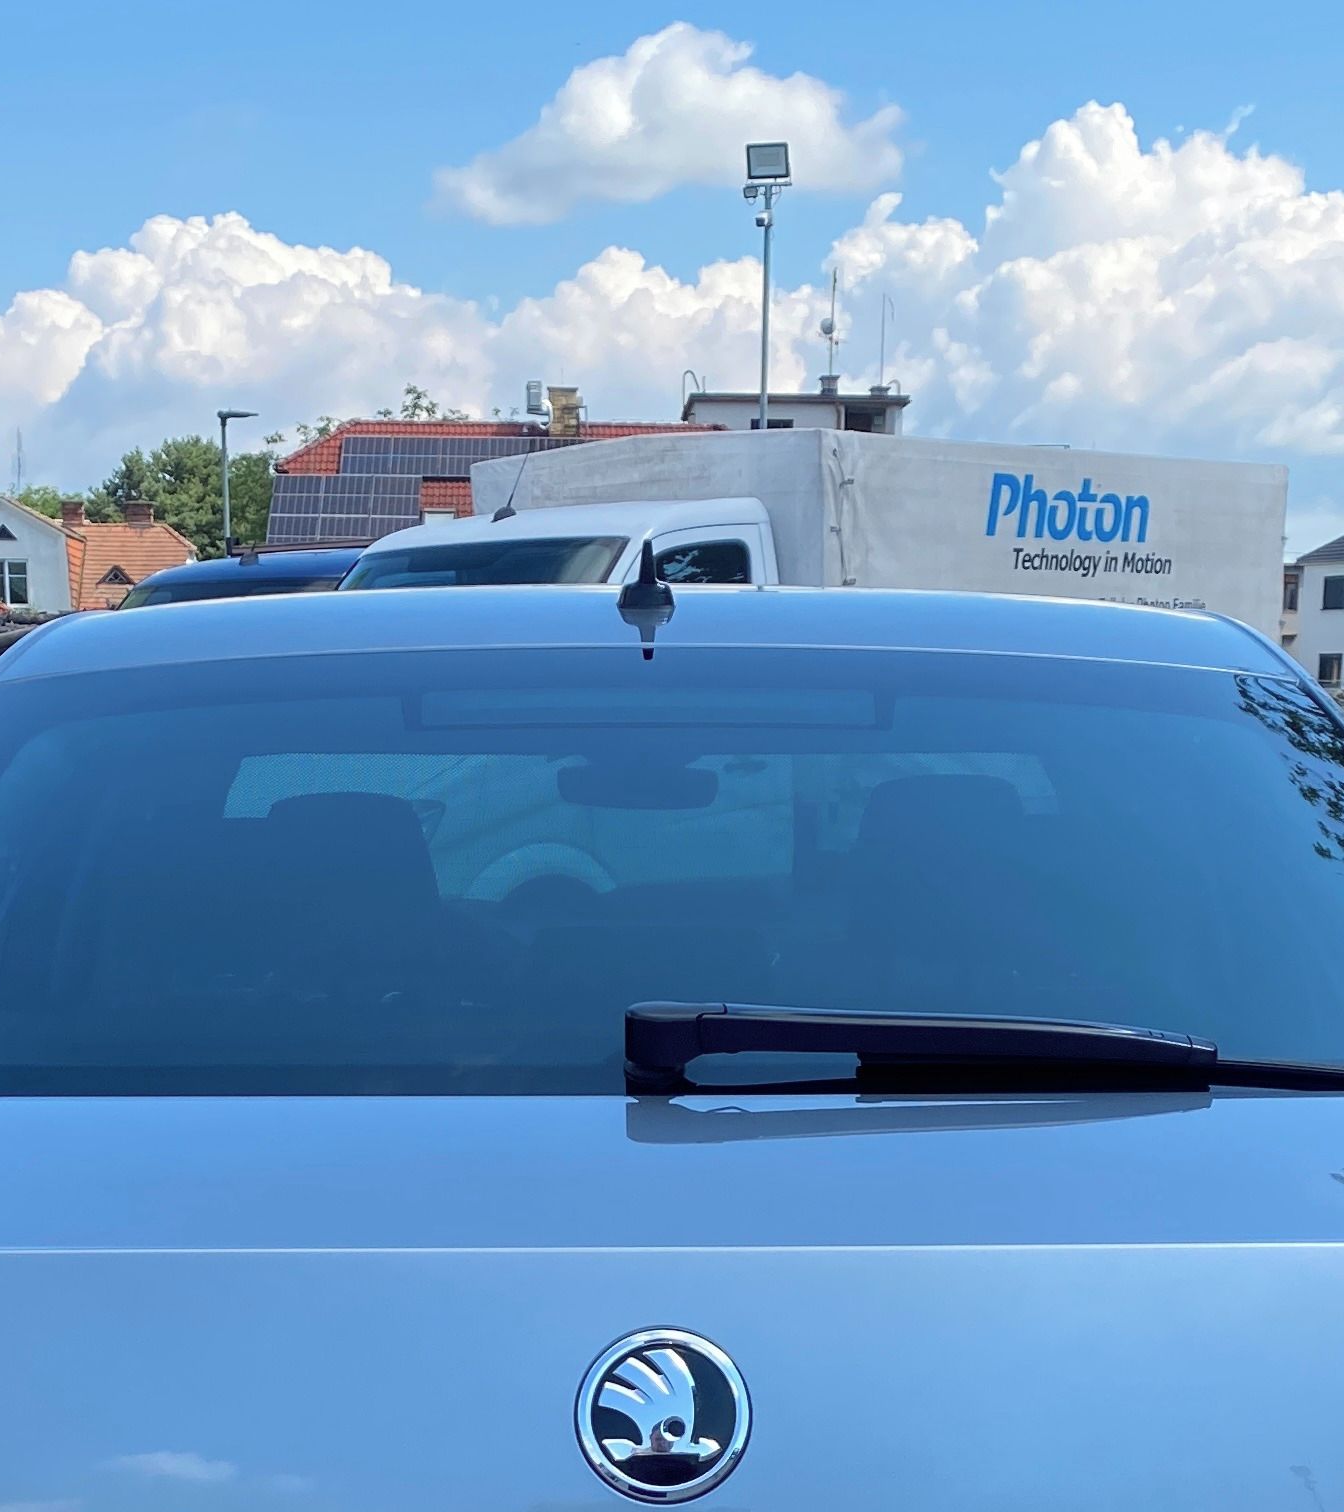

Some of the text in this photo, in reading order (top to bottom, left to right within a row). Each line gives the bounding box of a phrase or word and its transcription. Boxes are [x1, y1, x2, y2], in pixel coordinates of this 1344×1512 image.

[985, 472, 1150, 543] Photon
[1012, 547, 1173, 578] Technology in Motion
